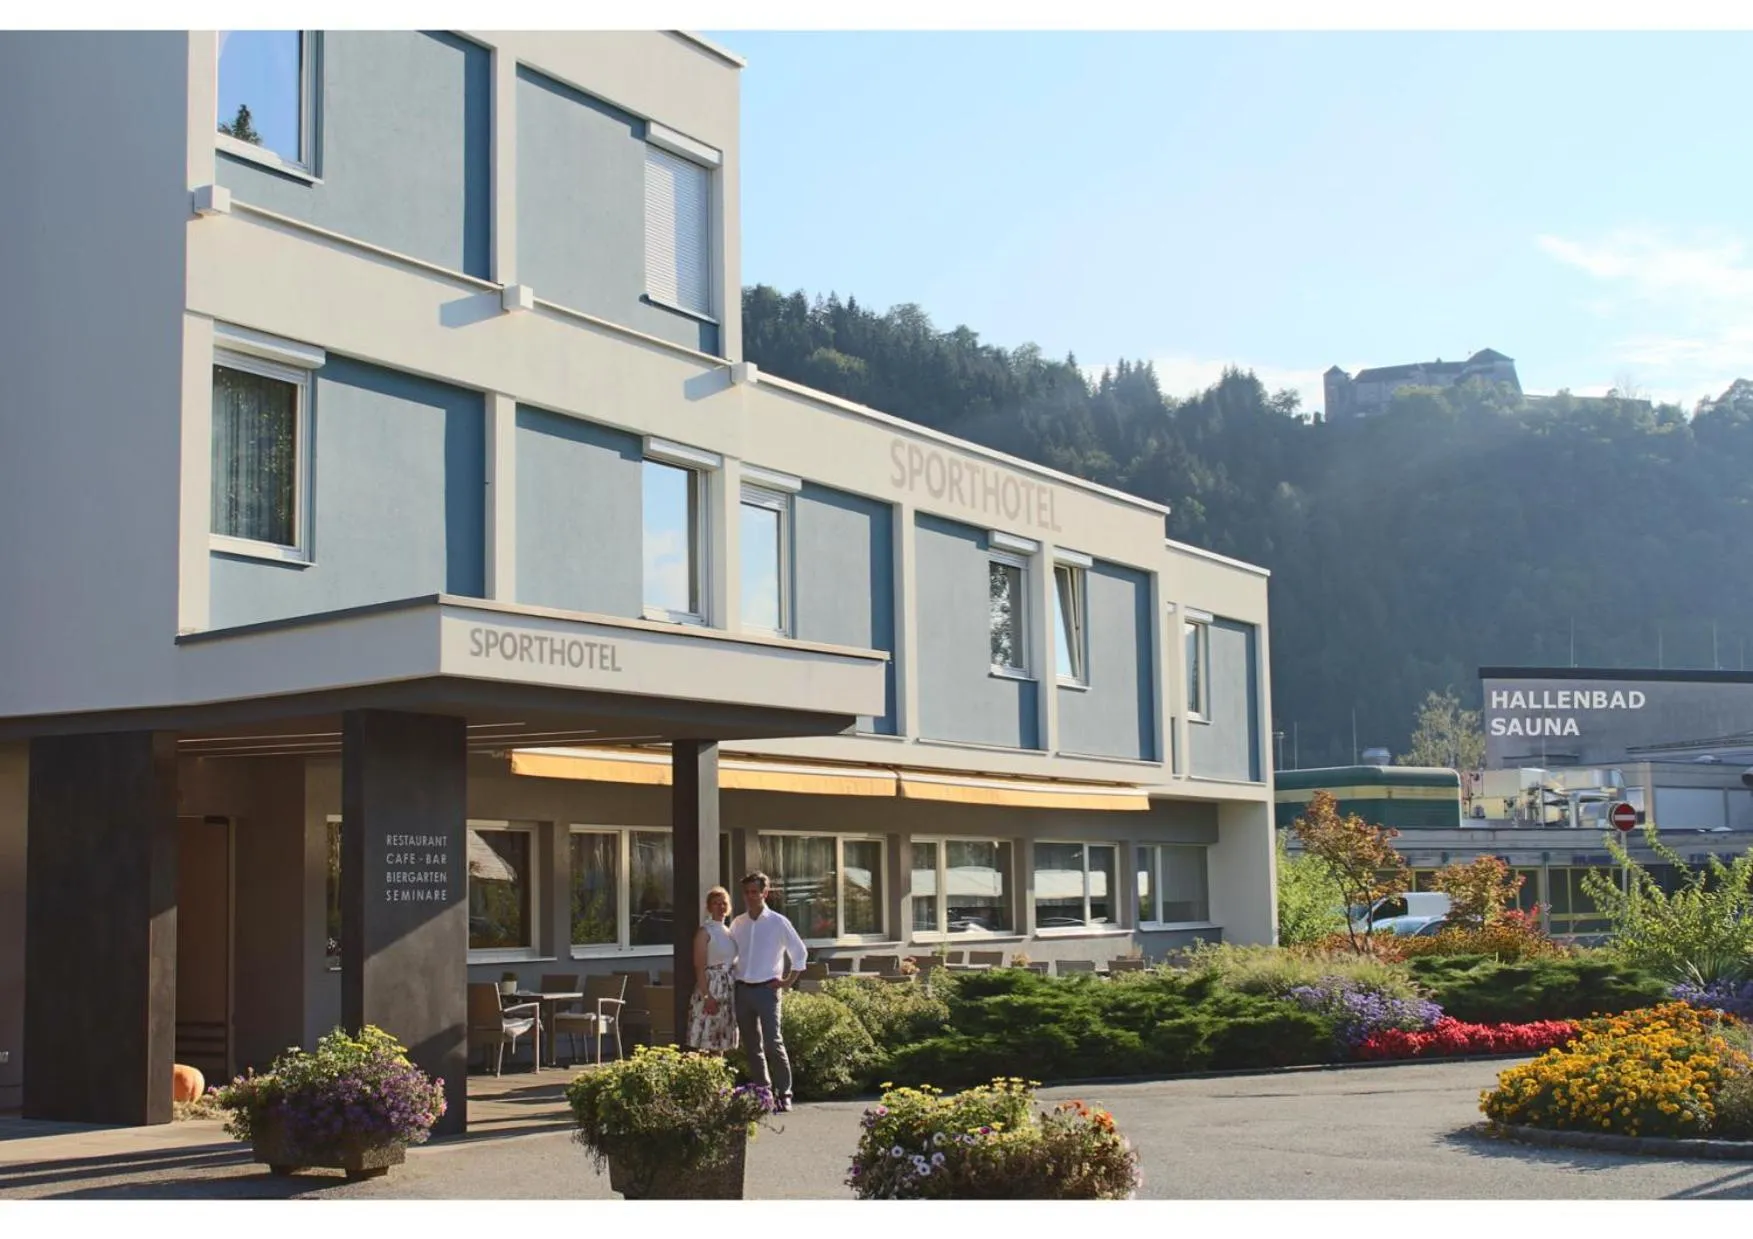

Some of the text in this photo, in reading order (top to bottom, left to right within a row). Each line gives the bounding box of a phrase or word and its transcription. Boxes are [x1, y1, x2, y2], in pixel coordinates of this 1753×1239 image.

[890, 437, 1062, 533] SPORTHOTEL
[470, 627, 622, 672] SPORTHOTEL
[1491, 690, 1646, 709] HALLENBAD
[1491, 717, 1580, 736] SAUNA
[386, 834, 447, 846] RESTAURANT
[386, 871, 447, 883] BIERGARTEN
[386, 889, 447, 901] SEMINARE
